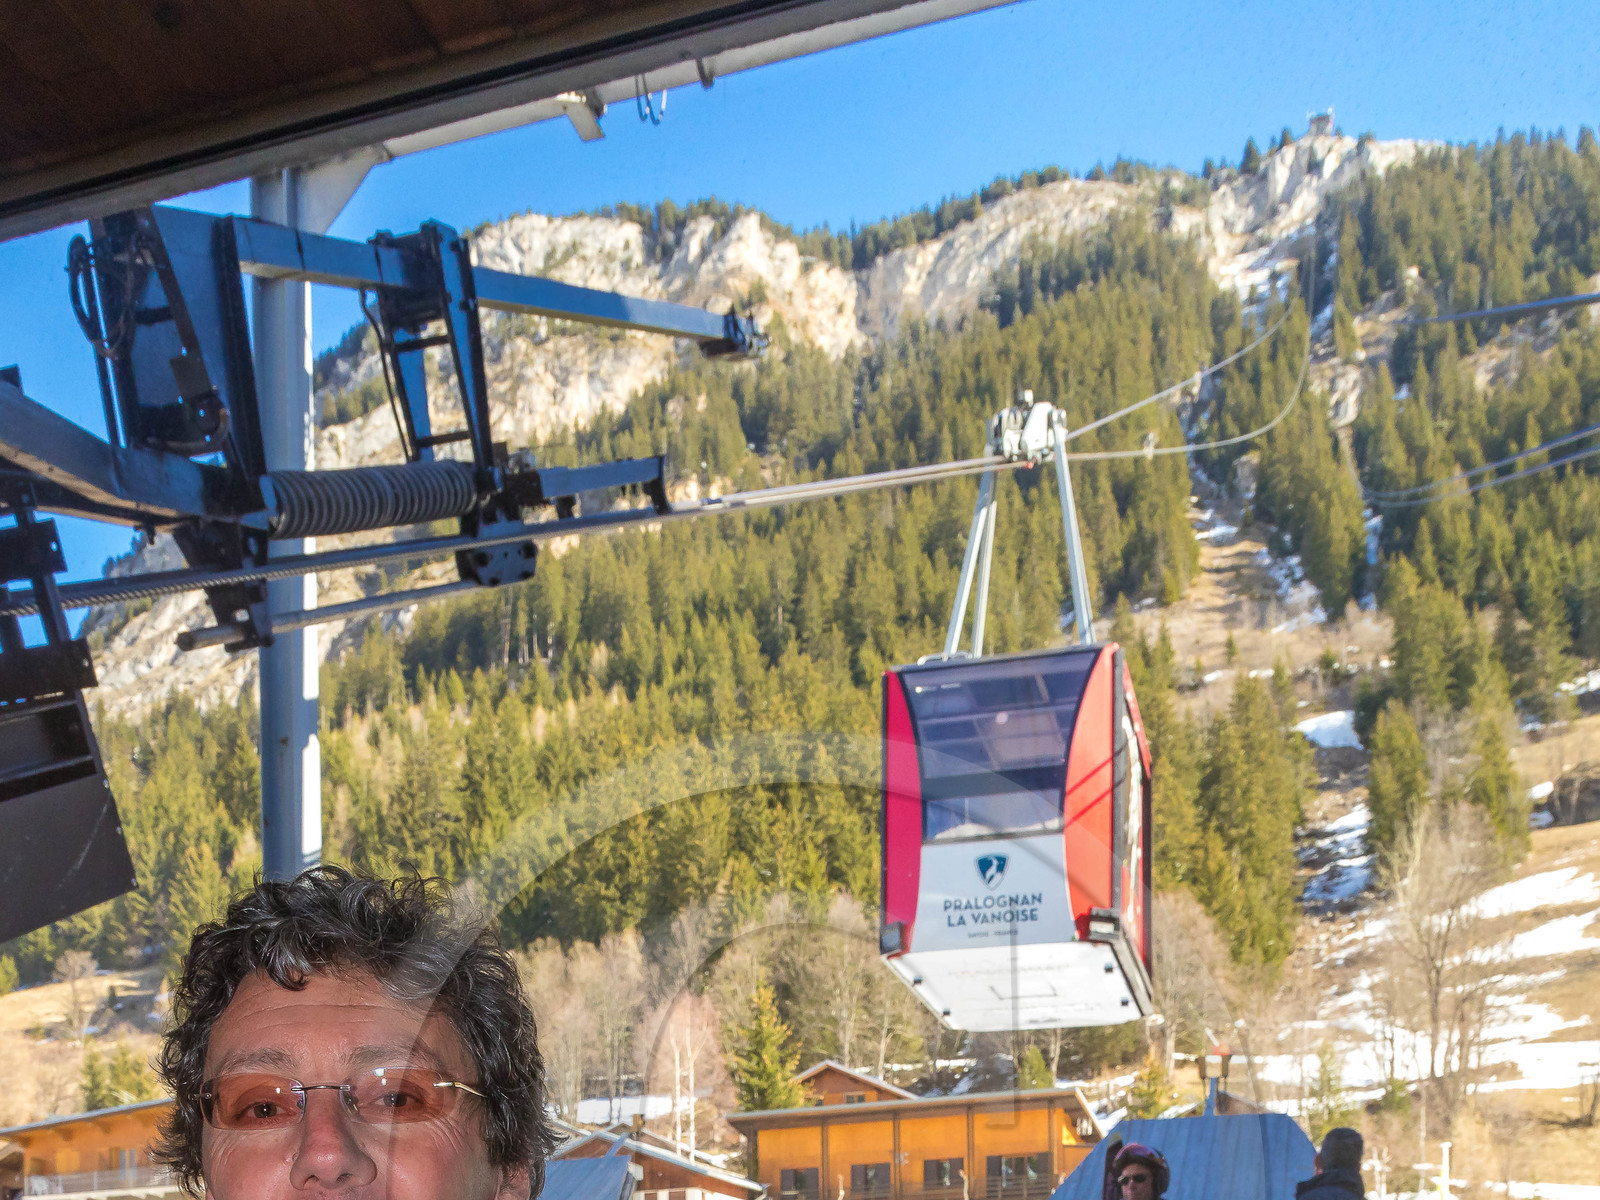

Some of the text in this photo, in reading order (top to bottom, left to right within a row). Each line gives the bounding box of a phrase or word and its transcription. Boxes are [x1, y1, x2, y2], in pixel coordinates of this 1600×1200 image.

[943, 892, 1042, 911] PRALOGNAN
[947, 908, 1039, 927] LA VANOISE
